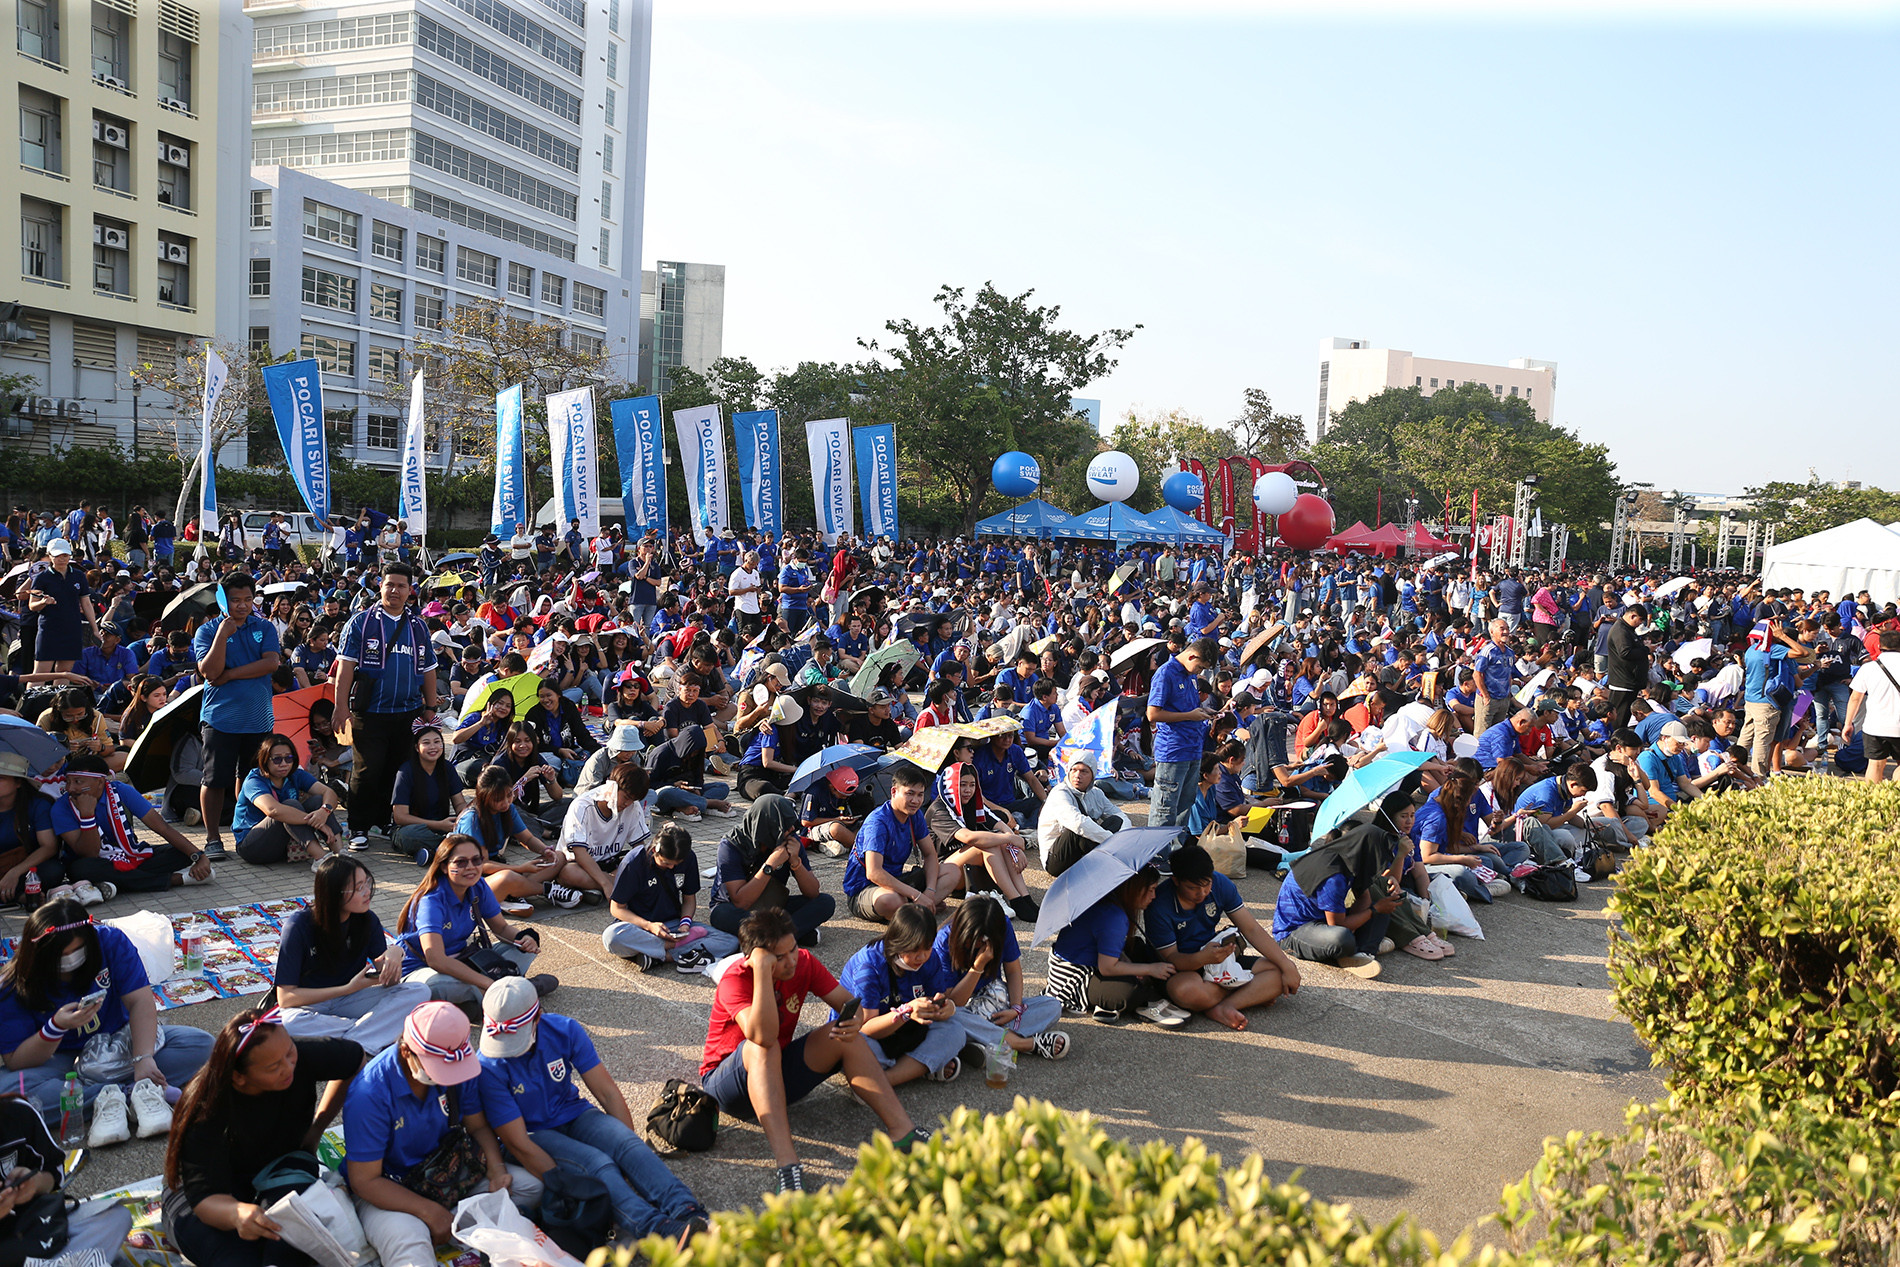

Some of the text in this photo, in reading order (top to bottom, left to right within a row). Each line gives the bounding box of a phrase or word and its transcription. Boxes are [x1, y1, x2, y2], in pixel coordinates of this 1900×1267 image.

[207, 375, 219, 411] POC
[294, 376, 319, 446] POCARI
[406, 455, 423, 515] SWEAT
[503, 465, 516, 521] SWEAT
[571, 402, 589, 520] POCARI SWEAT
[638, 409, 660, 523] POCARI SWEAT
[700, 418, 719, 526] POCARI SWEAT
[757, 422, 774, 527] POCARI SWEAT
[829, 431, 845, 530] POCARI SWEAT
[875, 435, 895, 532] POCARI SWEAT
[942, 766, 956, 808] AND
[587, 842, 620, 857] AILAND
